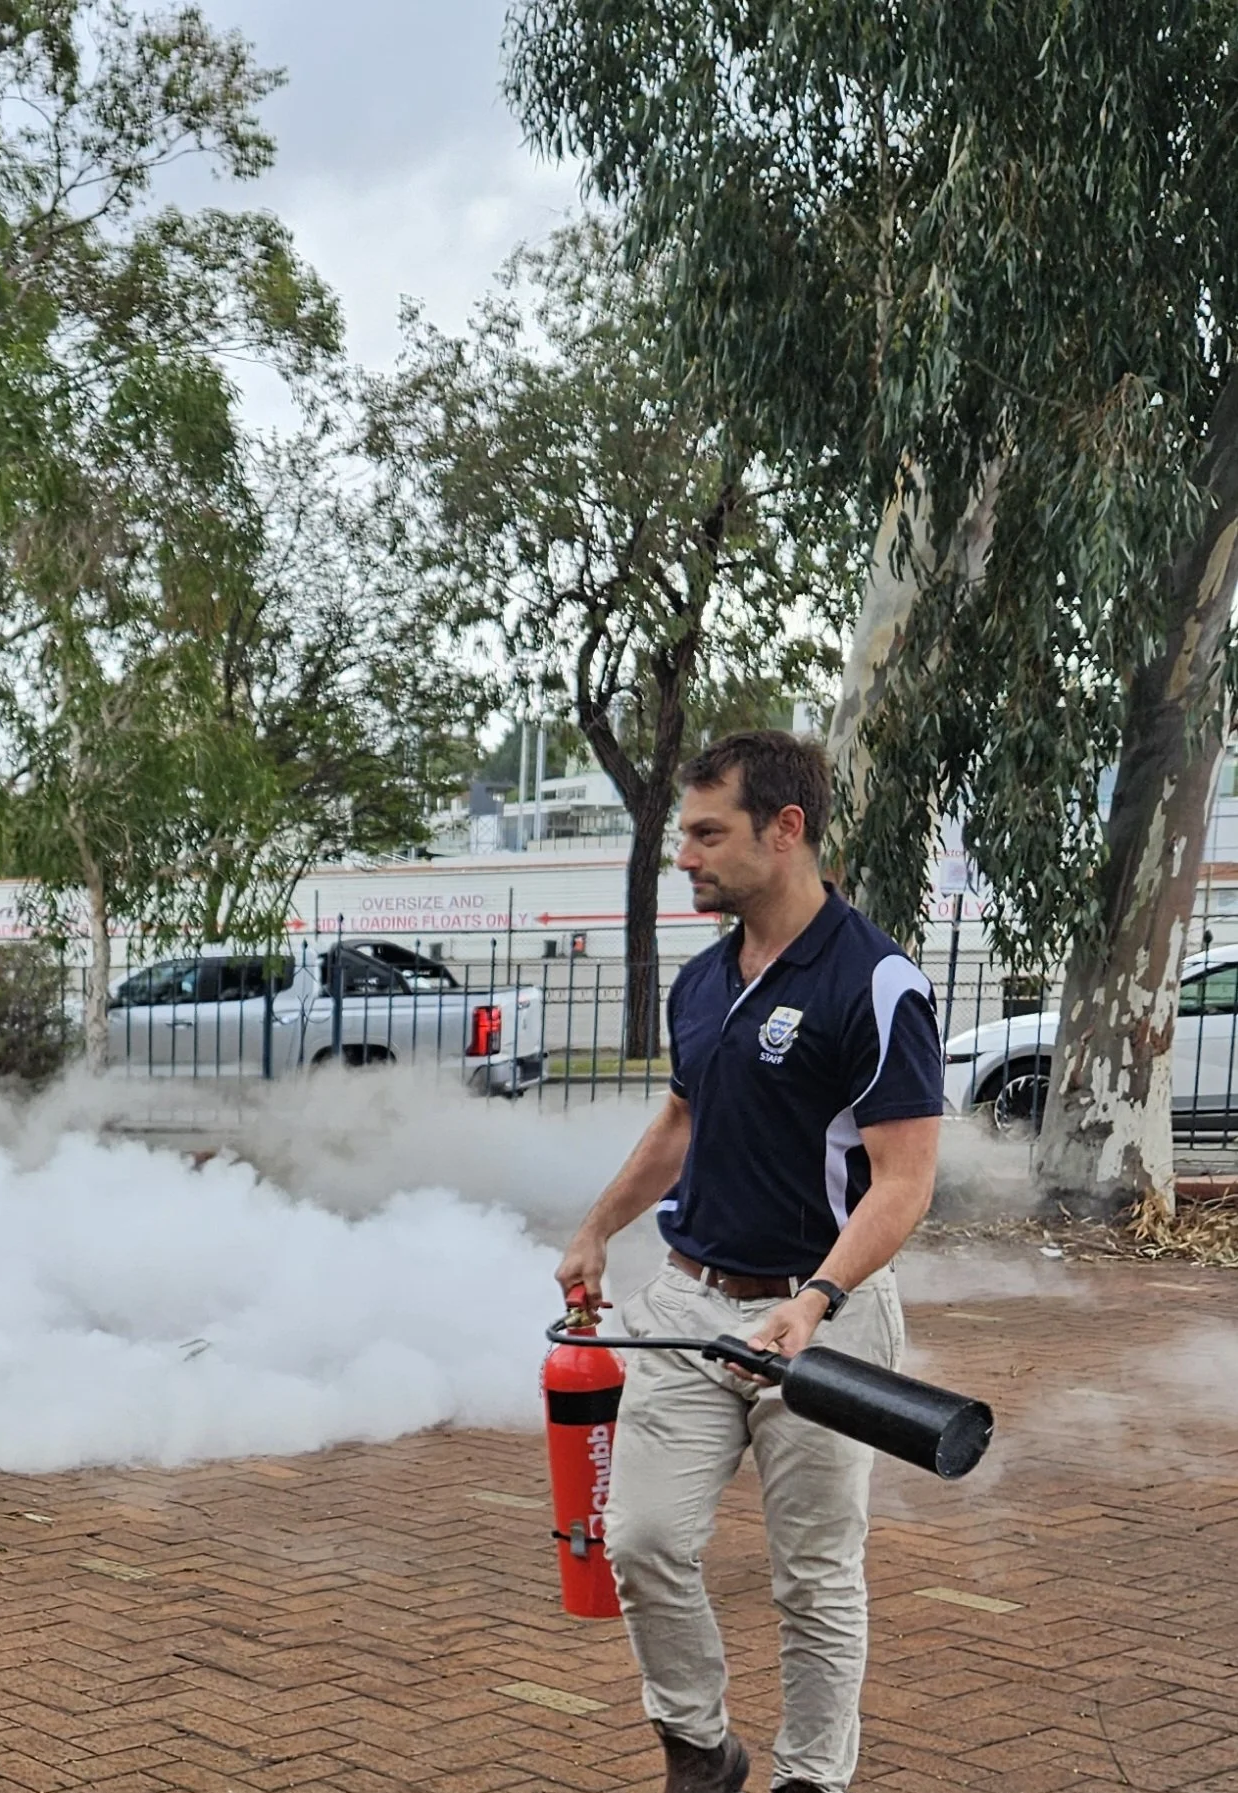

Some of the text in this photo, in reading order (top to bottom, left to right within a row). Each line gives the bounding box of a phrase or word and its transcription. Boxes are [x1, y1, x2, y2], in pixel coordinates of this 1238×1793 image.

[362, 894, 484, 911] OVERSIZE AND
[938, 901, 984, 916] OLY
[351, 915, 418, 930] LOADING
[422, 913, 482, 929] FLOATS
